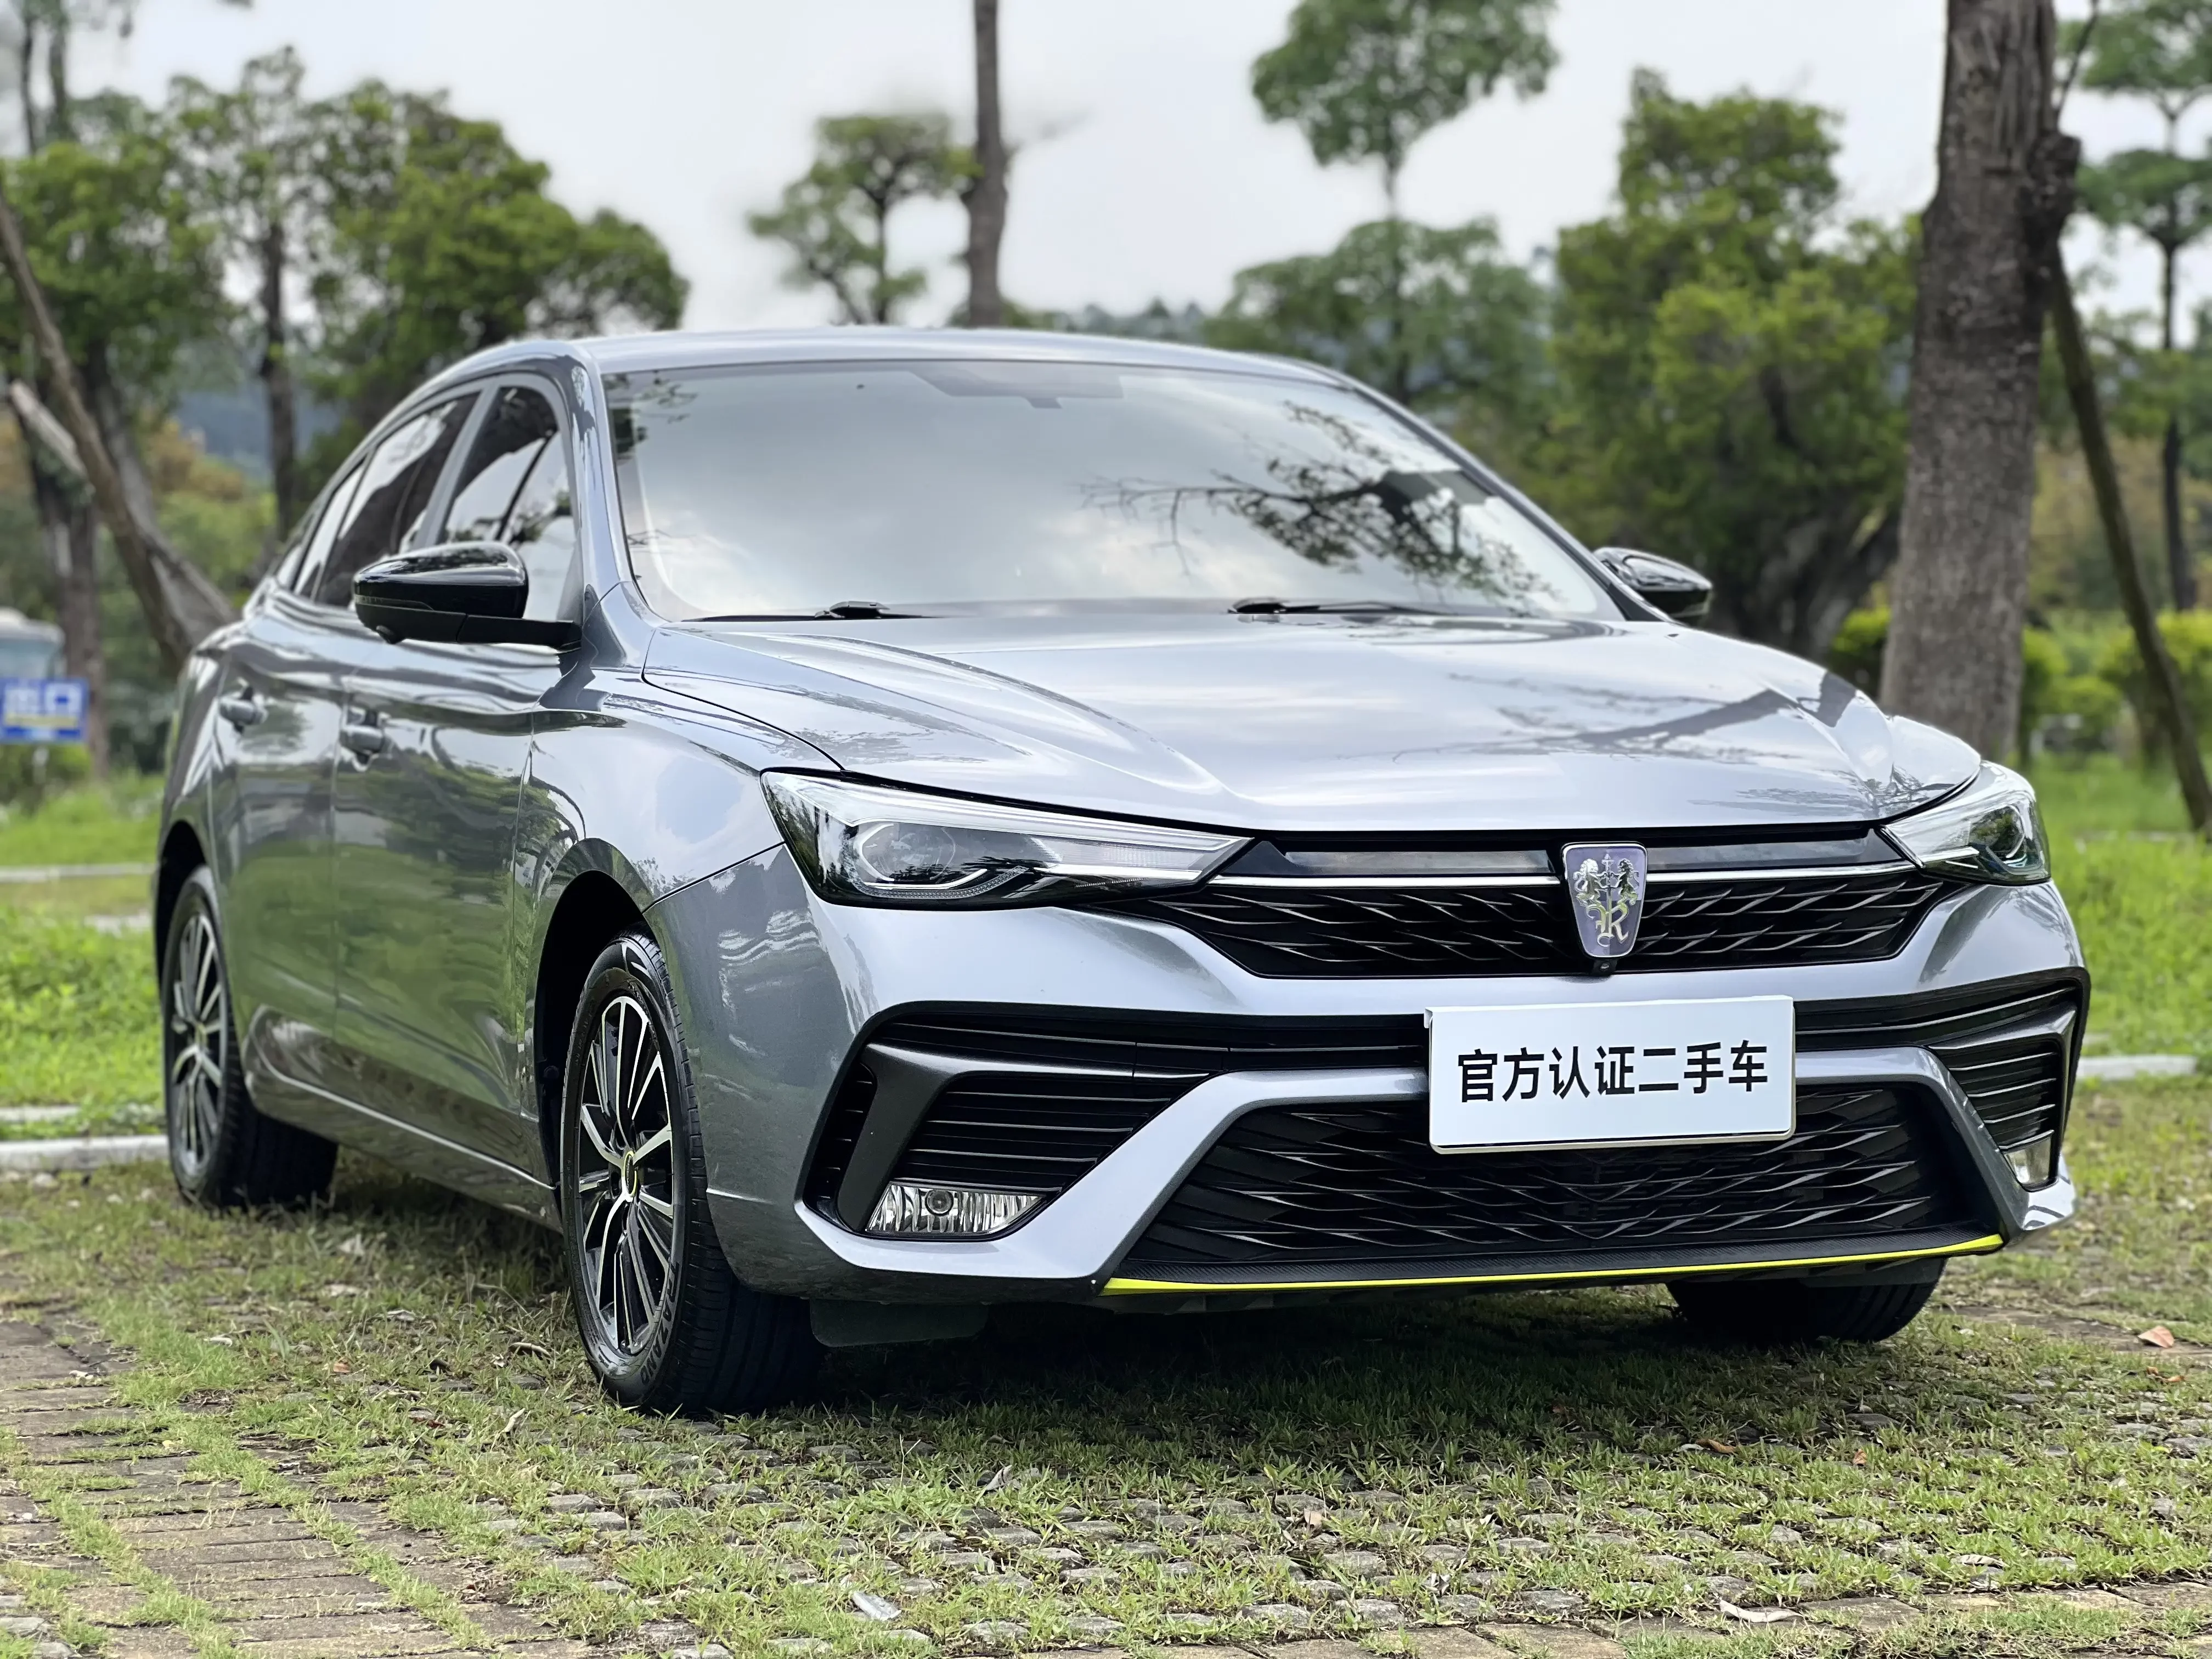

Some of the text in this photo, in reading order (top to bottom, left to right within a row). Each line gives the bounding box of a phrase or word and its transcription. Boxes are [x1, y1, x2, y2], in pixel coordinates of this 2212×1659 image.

[1457, 1040, 1768, 1103] 官方认证二手车
